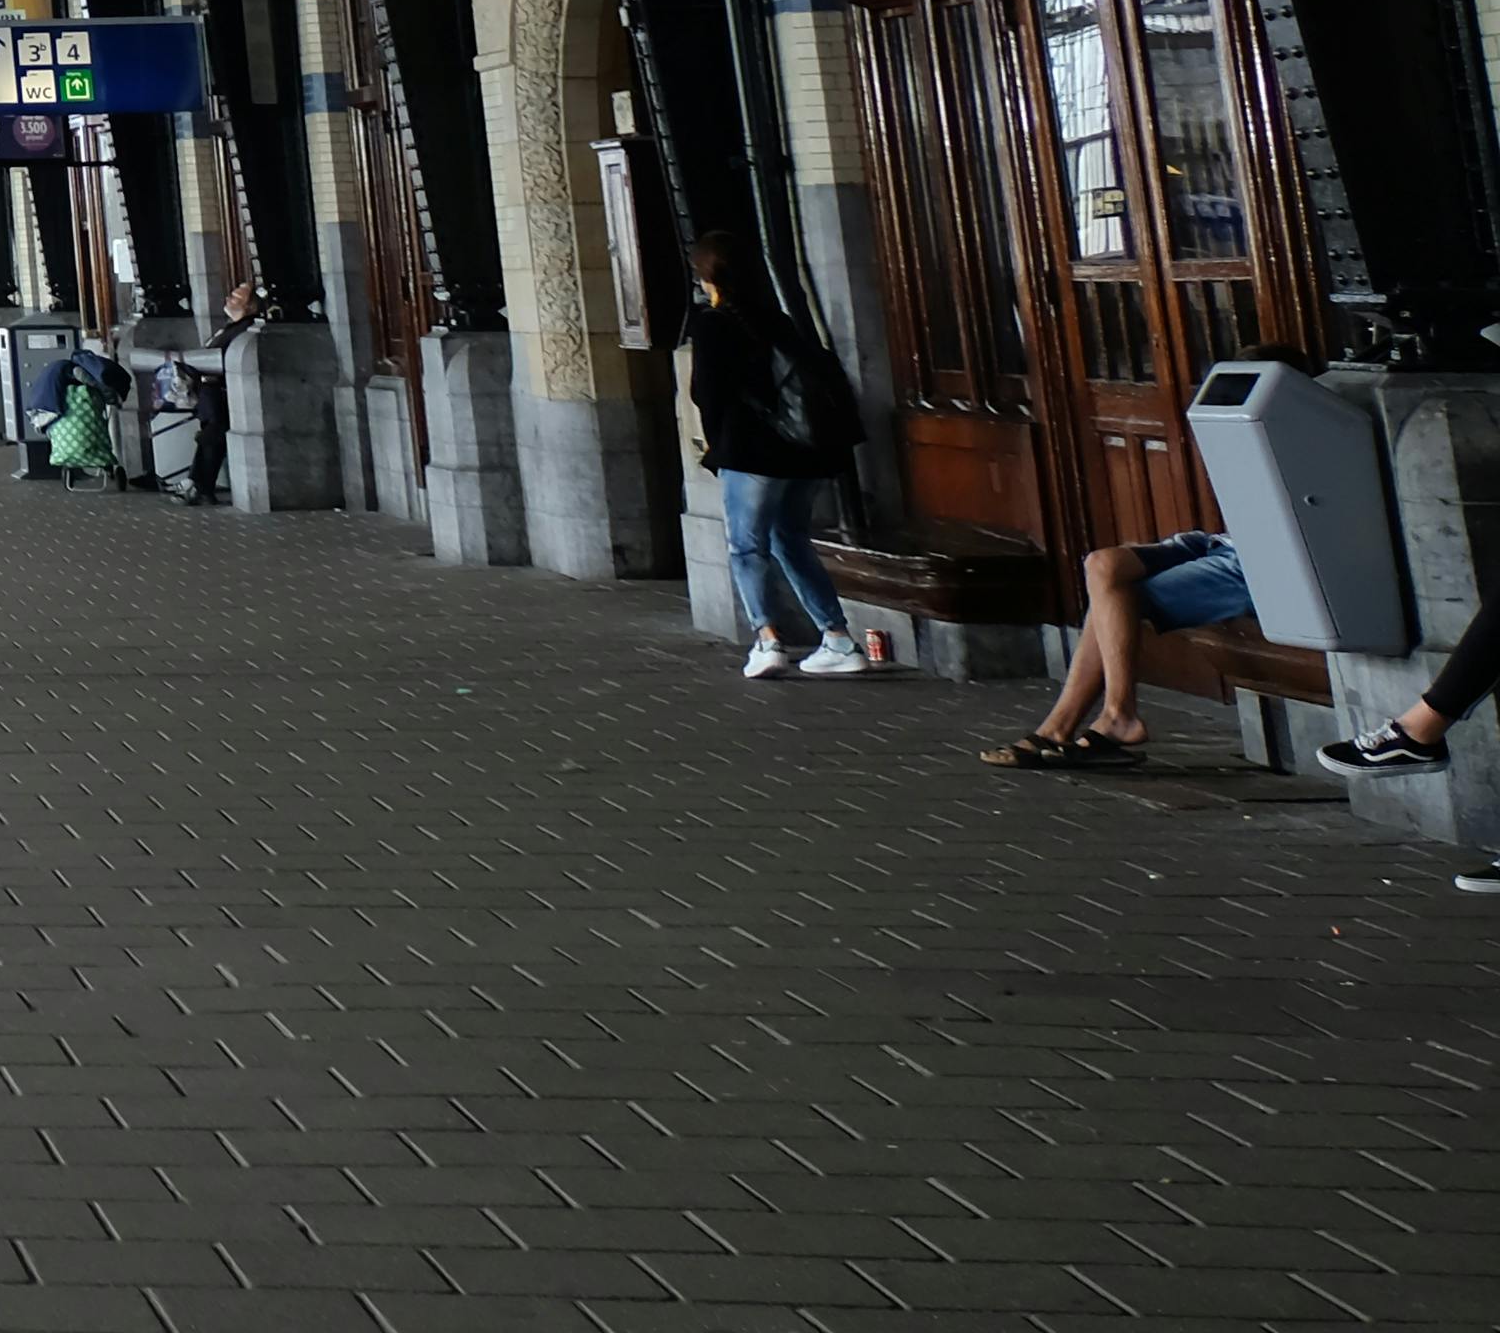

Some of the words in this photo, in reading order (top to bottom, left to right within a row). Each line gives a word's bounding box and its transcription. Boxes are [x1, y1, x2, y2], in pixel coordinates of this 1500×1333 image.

[66, 44, 80, 61] 4
[26, 87, 52, 99] WC
[19, 121, 47, 134] 3.500
